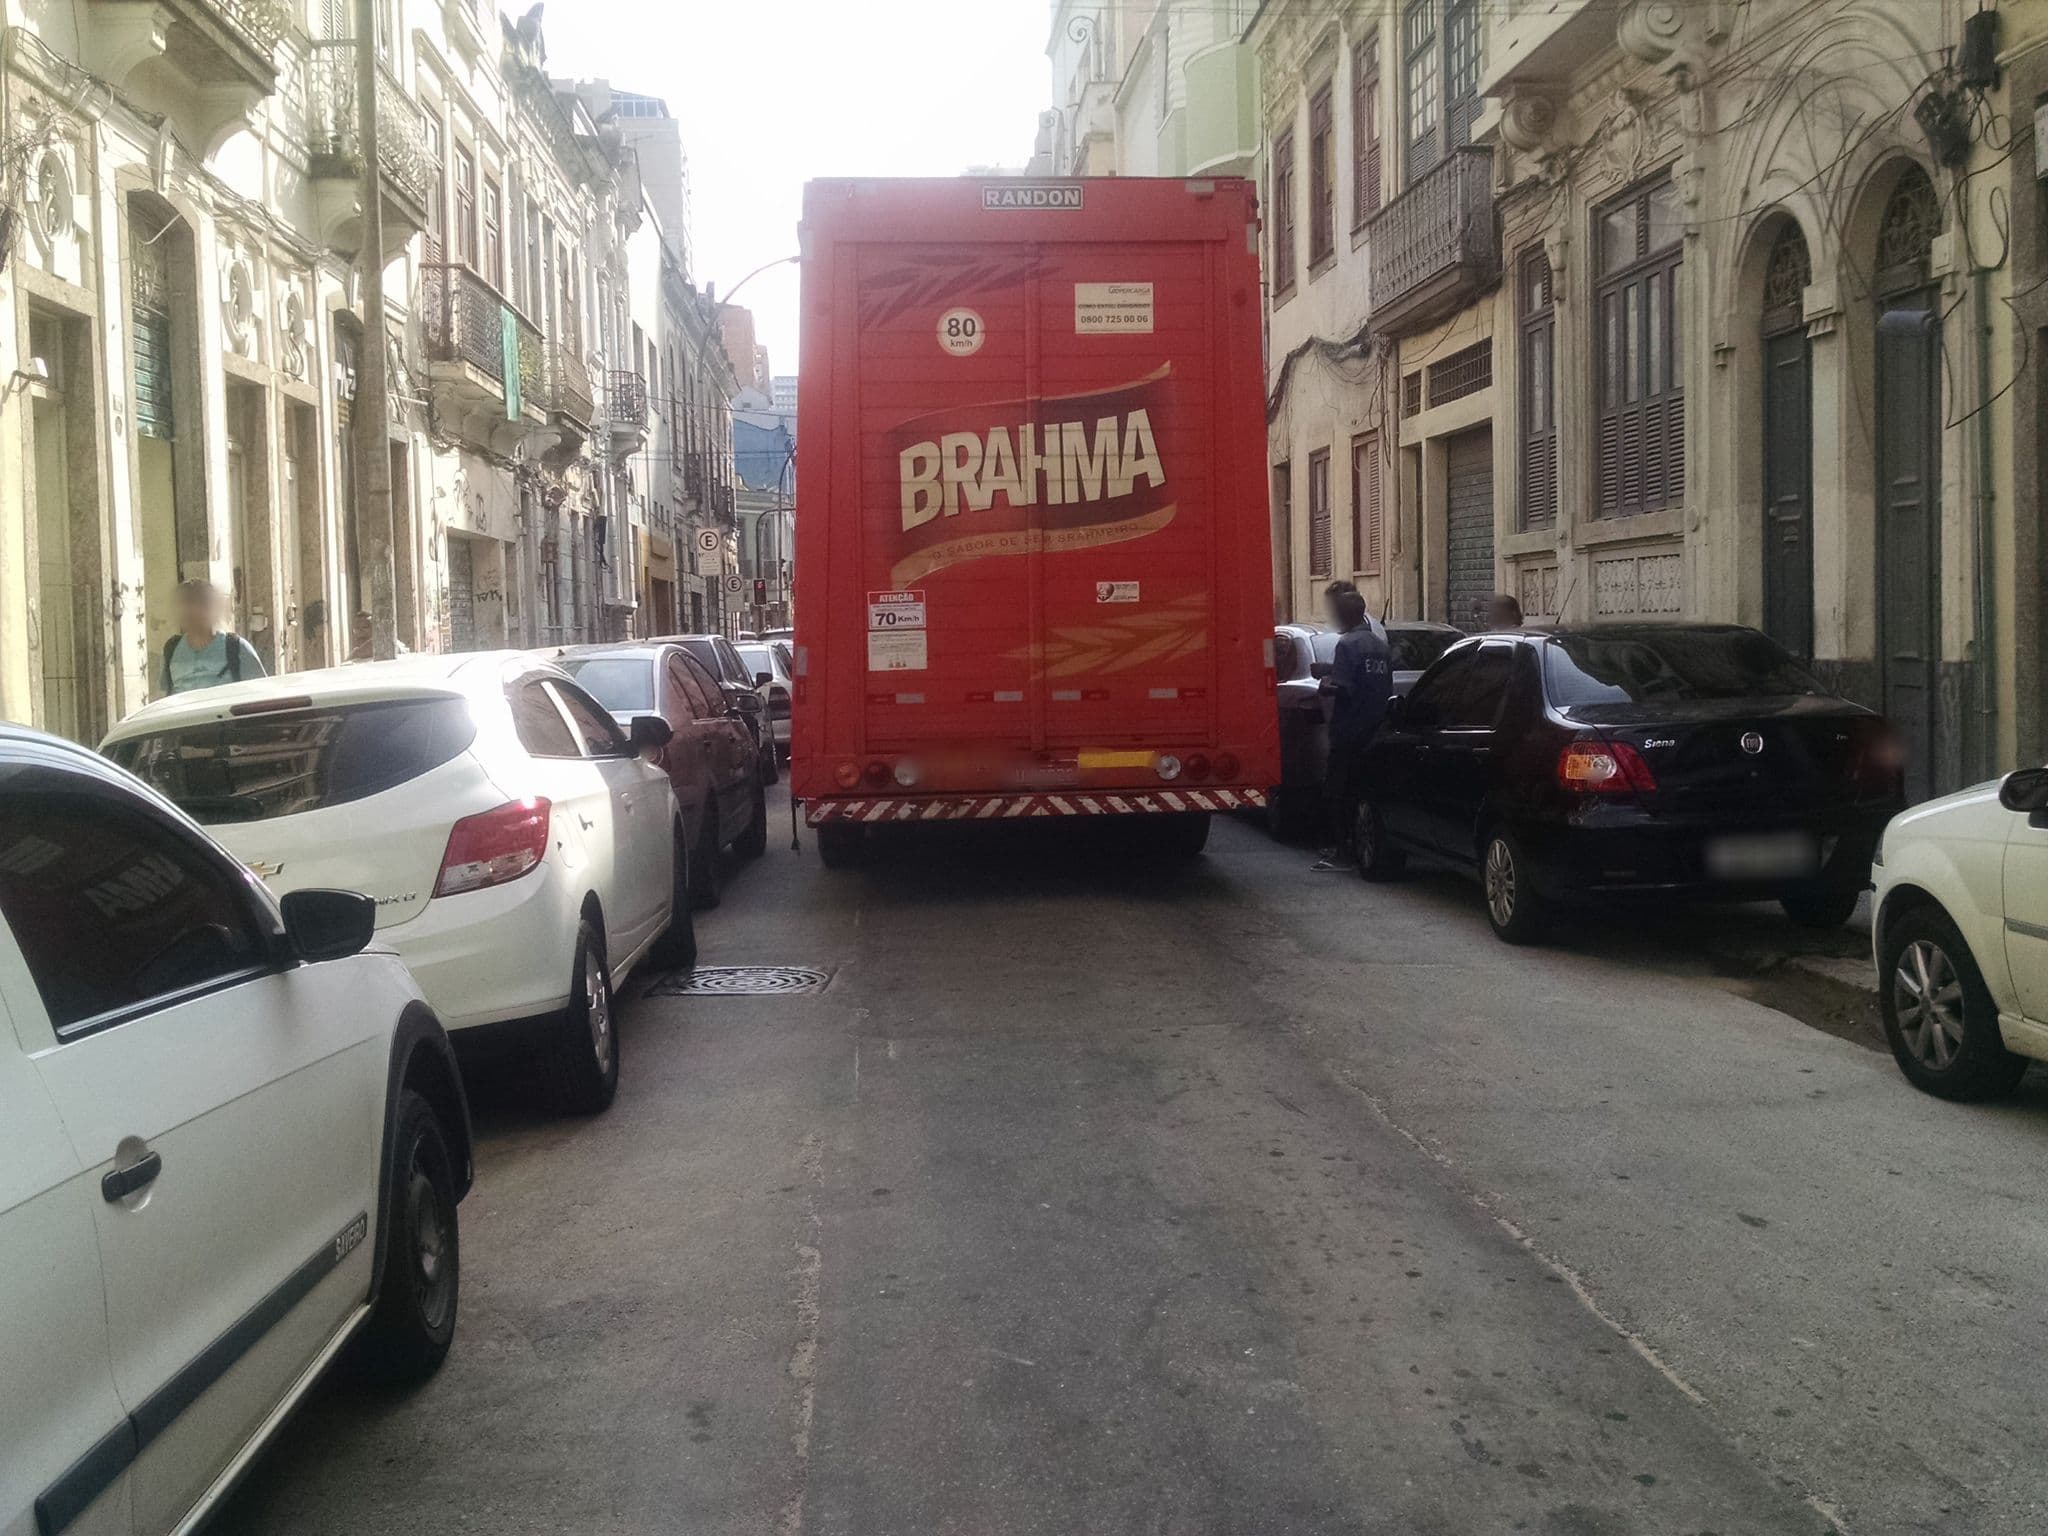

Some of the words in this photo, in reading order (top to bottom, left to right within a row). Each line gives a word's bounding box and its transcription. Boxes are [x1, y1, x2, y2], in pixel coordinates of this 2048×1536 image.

[986, 190, 1080, 205] RANDON
[1080, 315, 1103, 323] 0800
[1105, 315, 1121, 323] 725
[1123, 314, 1135, 322] 00
[948, 318, 976, 337] 80
[899, 408, 1166, 532] BRAHMA
[705, 535, 713, 547] E
[947, 540, 993, 556] SABOR
[1000, 536, 1017, 546] DE
[730, 579, 738, 589] E
[875, 612, 897, 626] 70
[1644, 738, 1675, 749] Siena
